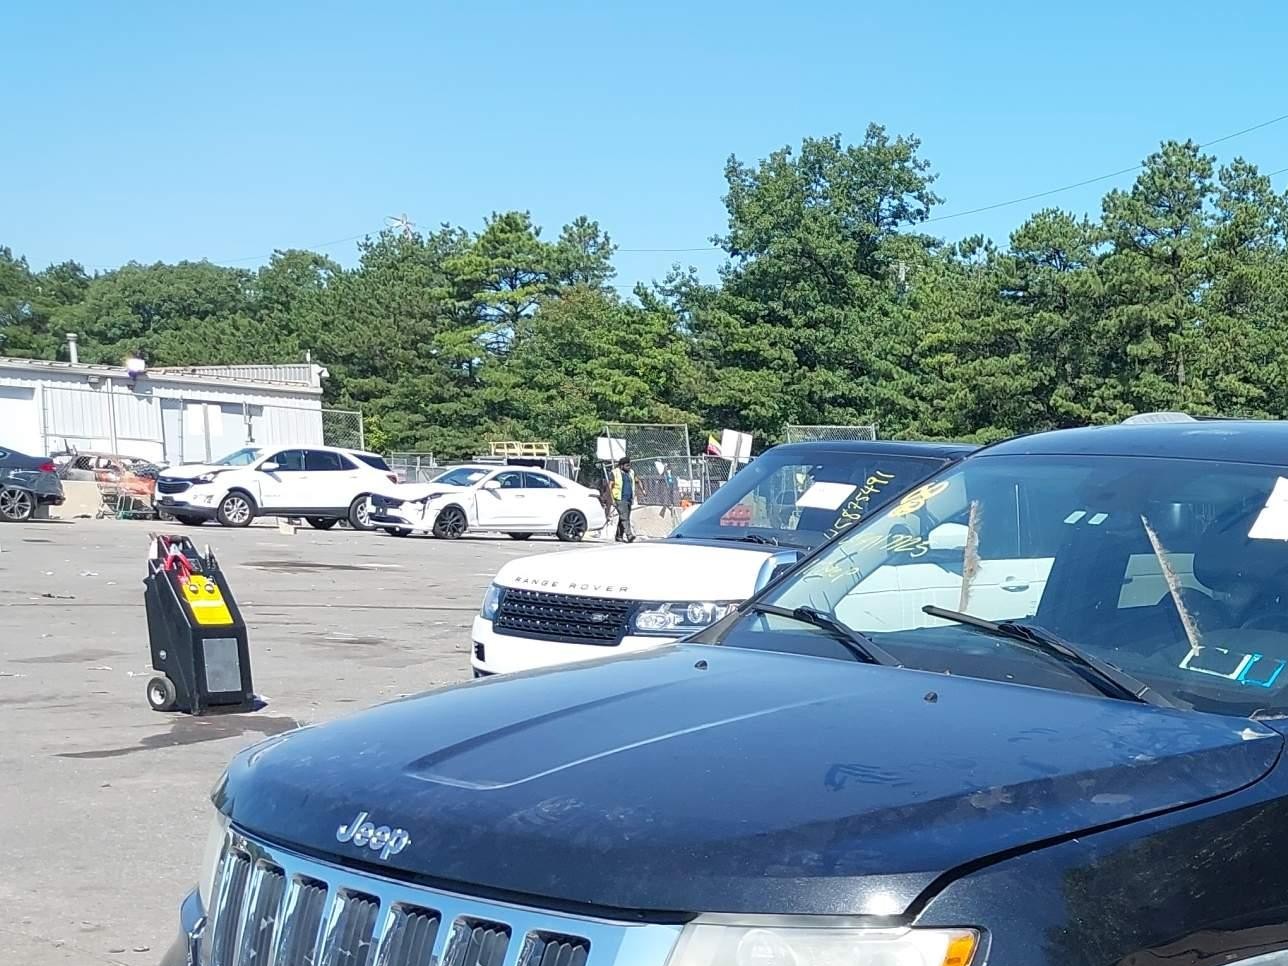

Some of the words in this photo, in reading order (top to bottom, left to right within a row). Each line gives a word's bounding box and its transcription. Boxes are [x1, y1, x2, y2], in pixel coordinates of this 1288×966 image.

[515, 576, 560, 588] RANGE
[568, 582, 629, 593] ROVER
[336, 811, 409, 860] Jeep
